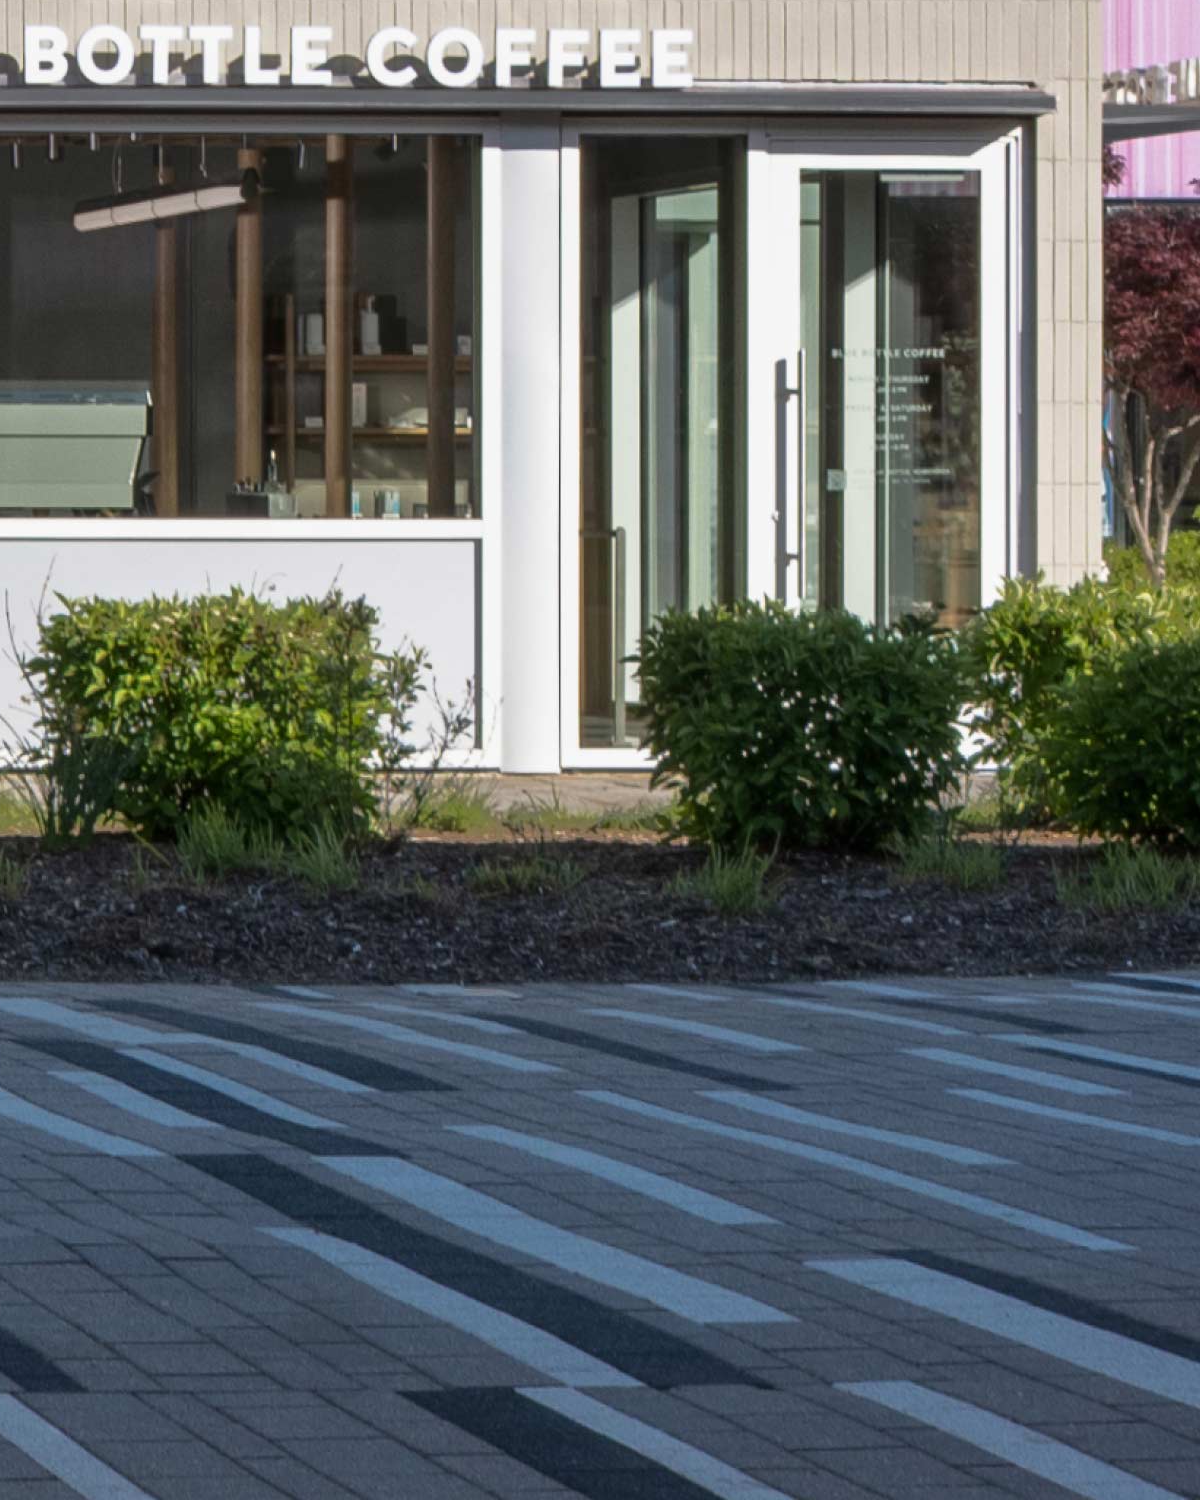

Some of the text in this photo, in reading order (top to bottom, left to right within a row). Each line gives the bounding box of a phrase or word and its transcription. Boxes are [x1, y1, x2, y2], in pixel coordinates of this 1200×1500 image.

[25, 25, 334, 85] BOTTLE
[367, 26, 693, 87] COFFEE
[903, 348, 946, 359] COFFEE
